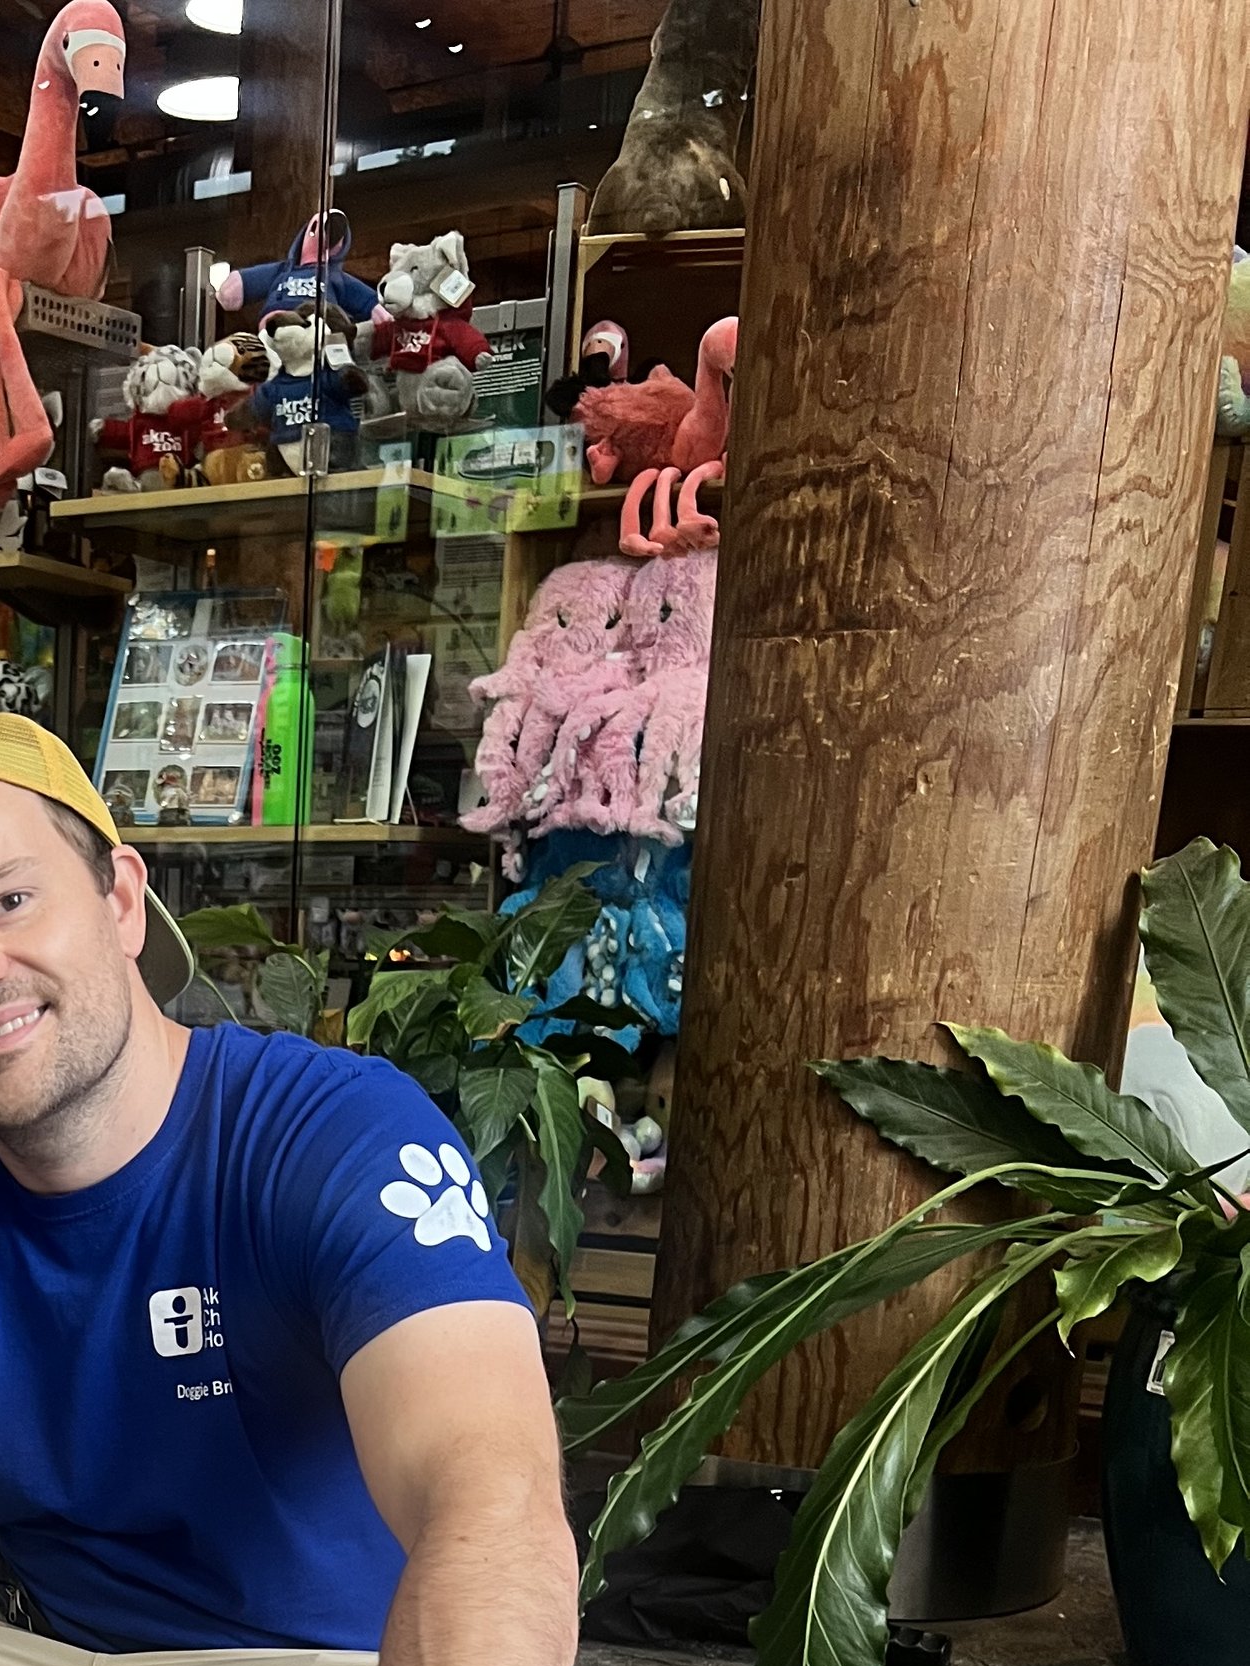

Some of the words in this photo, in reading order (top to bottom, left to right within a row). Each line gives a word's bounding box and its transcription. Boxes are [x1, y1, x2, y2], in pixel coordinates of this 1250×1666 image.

[153, 441, 182, 452] zoo
[203, 1330, 225, 1349] Ho
[176, 1382, 210, 1401] Doggie
